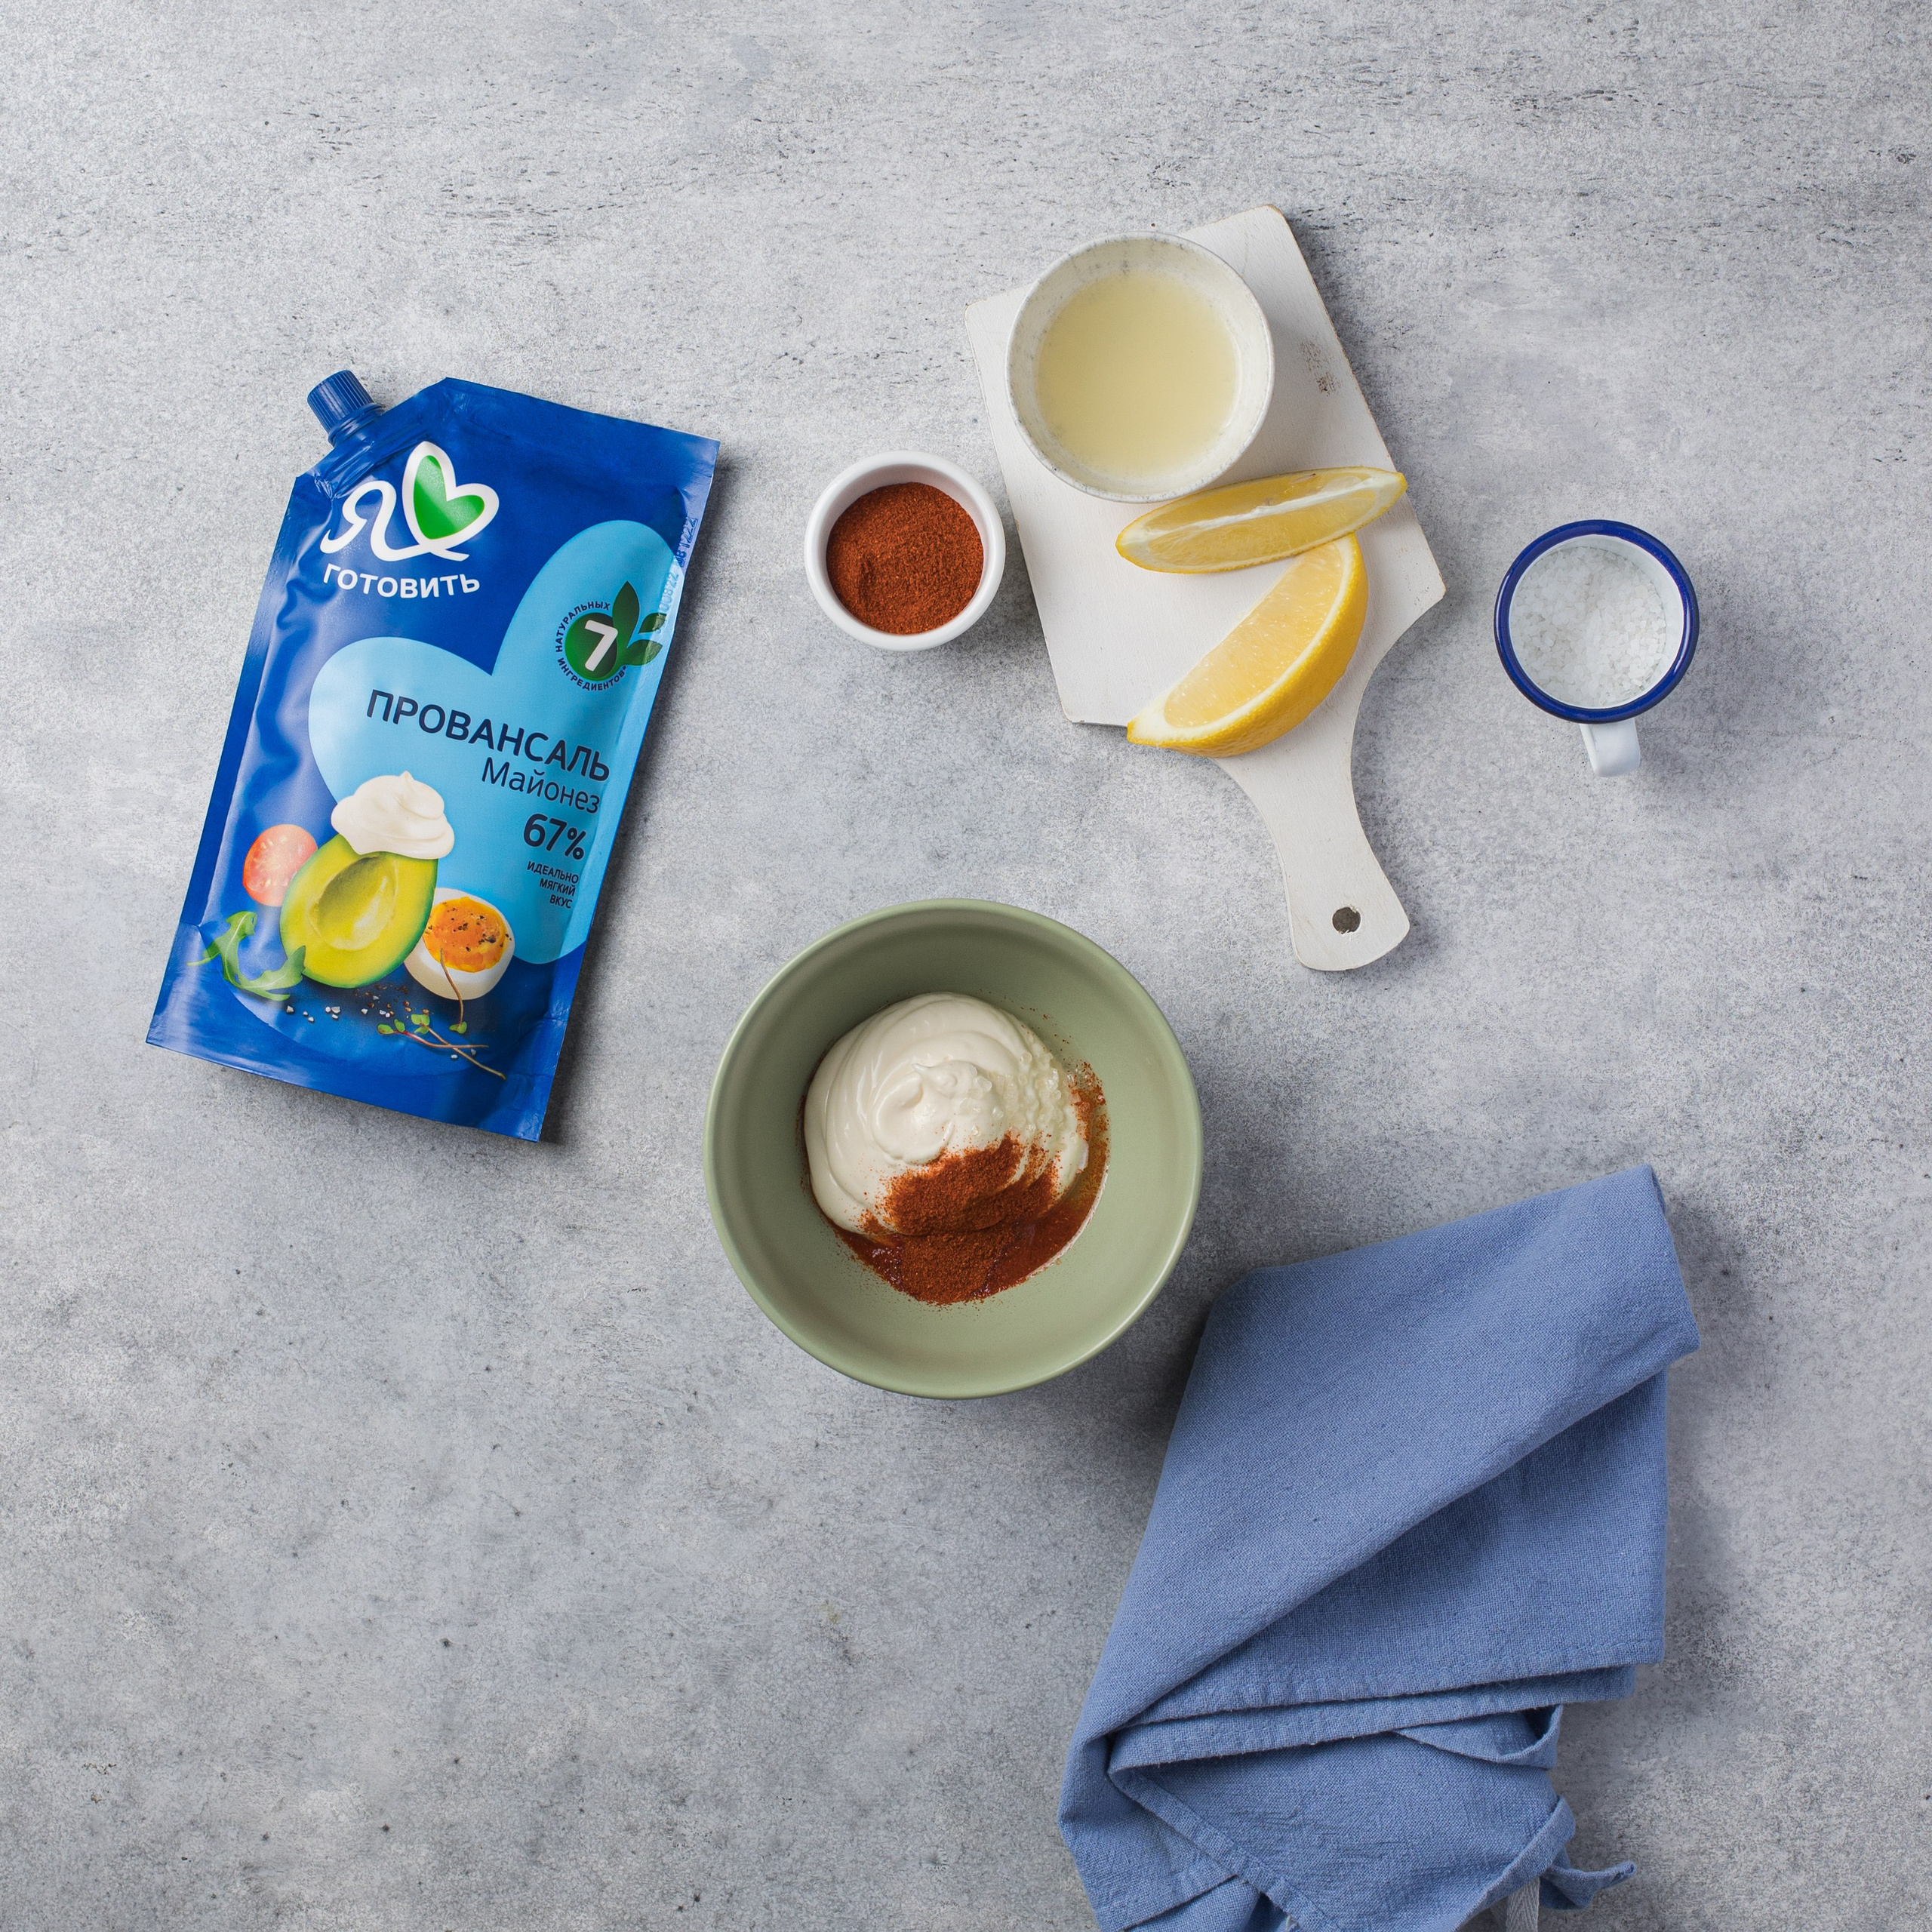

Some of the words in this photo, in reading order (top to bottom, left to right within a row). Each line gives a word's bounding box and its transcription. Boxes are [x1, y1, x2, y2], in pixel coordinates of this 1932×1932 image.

[323, 563, 480, 598] ГОТОВИТЬ
[555, 601, 611, 653] НАТУРАЛЬНЫХ
[585, 620, 619, 672] 7
[367, 689, 610, 782] ПРОВАНСАЛЬ
[481, 757, 601, 814] Майонез
[524, 814, 586, 860] 67%
[527, 861, 579, 884] ИДЕАЛЬНО
[539, 878, 576, 897] МЯГКИЙ
[549, 894, 573, 909] ВКУС
